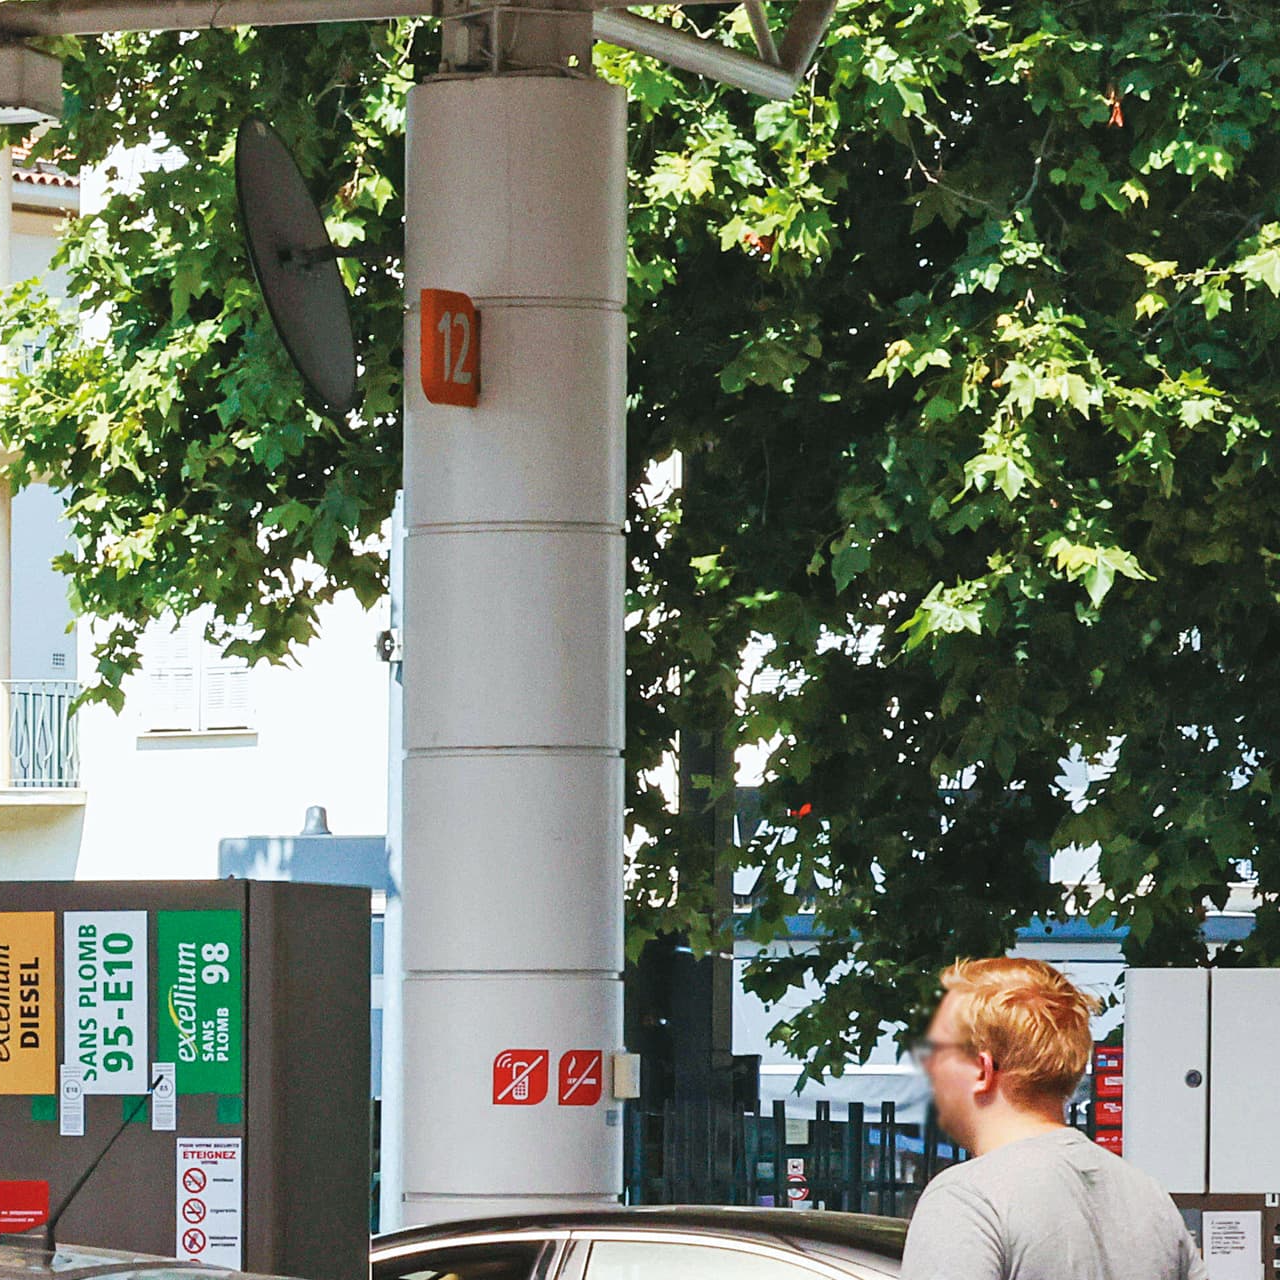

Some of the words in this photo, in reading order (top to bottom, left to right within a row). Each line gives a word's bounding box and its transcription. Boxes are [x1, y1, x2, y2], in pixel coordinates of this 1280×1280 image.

[437, 310, 473, 385] 12
[79, 923, 97, 1008] PLOMB
[202, 942, 230, 985] 98
[20, 957, 40, 1049] DIESEL
[103, 932, 134, 1073] 95-E10
[177, 942, 197, 1063] excellium
[217, 1007, 230, 1062] PLOMB
[79, 1014, 98, 1081] SANS
[202, 1020, 215, 1062] SANS
[182, 1151, 237, 1160] ETEIGNEZ
